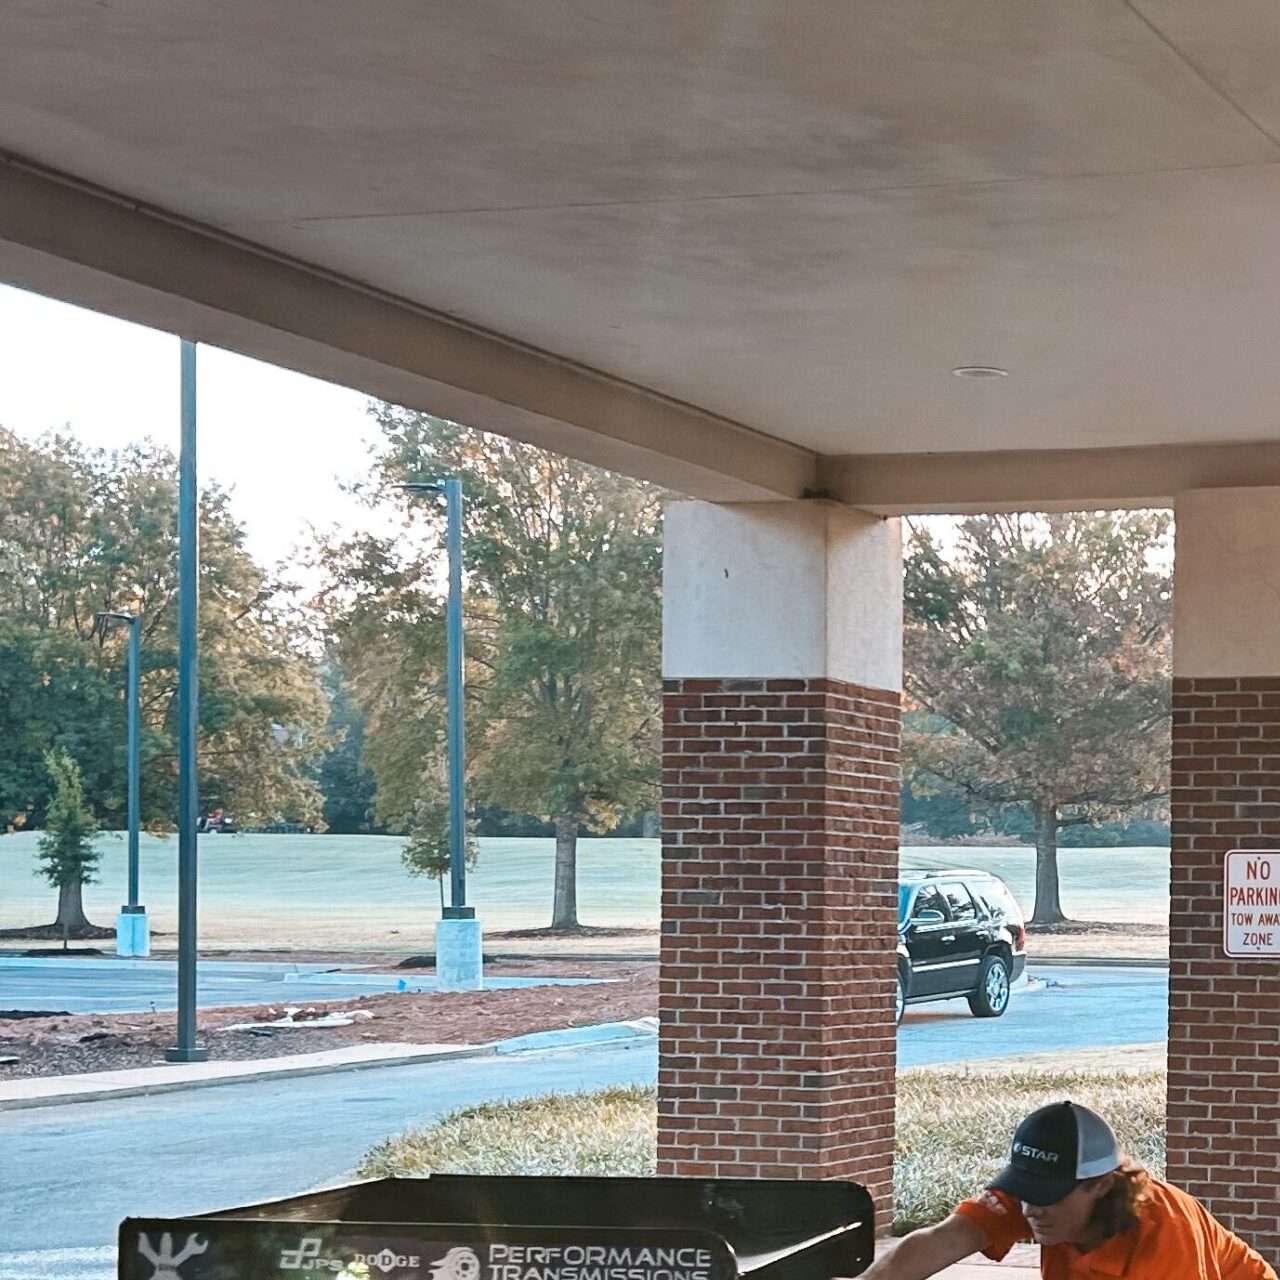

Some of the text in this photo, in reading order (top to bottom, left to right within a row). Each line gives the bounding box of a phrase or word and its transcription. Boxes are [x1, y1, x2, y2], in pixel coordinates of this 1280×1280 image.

[1246, 860, 1271, 880] NO
[1231, 912, 1254, 926] TOW
[1242, 932, 1273, 946] ZONE
[355, 1248, 420, 1273] DODGE
[488, 1244, 712, 1267] PERFORMANCE
